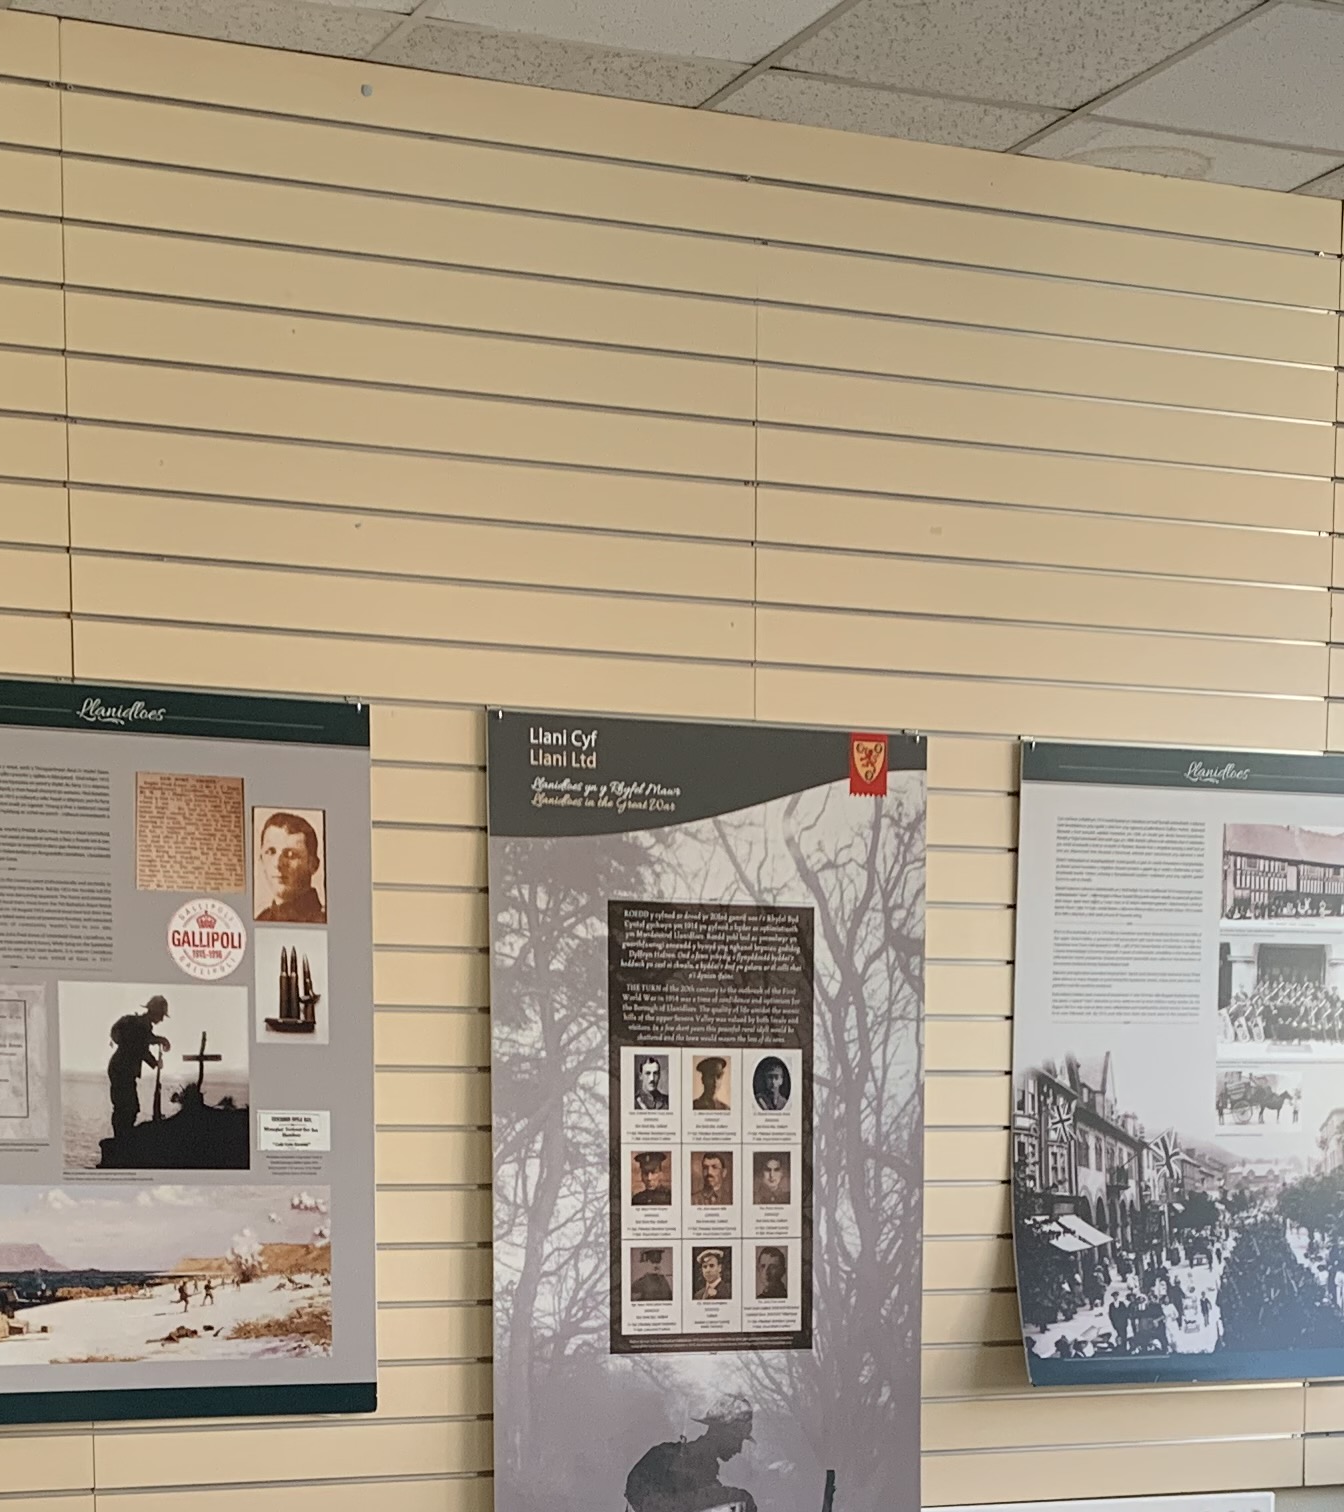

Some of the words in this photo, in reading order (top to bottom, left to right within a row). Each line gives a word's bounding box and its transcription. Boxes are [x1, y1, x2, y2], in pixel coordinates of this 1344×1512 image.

[76, 698, 166, 725] Llanidloes
[530, 727, 567, 745] Llani
[571, 730, 598, 750] Cyf
[530, 748, 567, 767] Llani
[571, 751, 597, 769] Ltd
[1184, 761, 1250, 784] Llanidloes
[531, 776, 583, 792] Llanidloes
[584, 784, 597, 797] yn
[599, 785, 607, 797] y
[531, 792, 583, 807] Llanidloes
[584, 798, 595, 807] in
[597, 796, 613, 808] the
[616, 798, 647, 814] Great
[649, 798, 676, 812] War
[172, 929, 241, 949] GALLIPOLI
